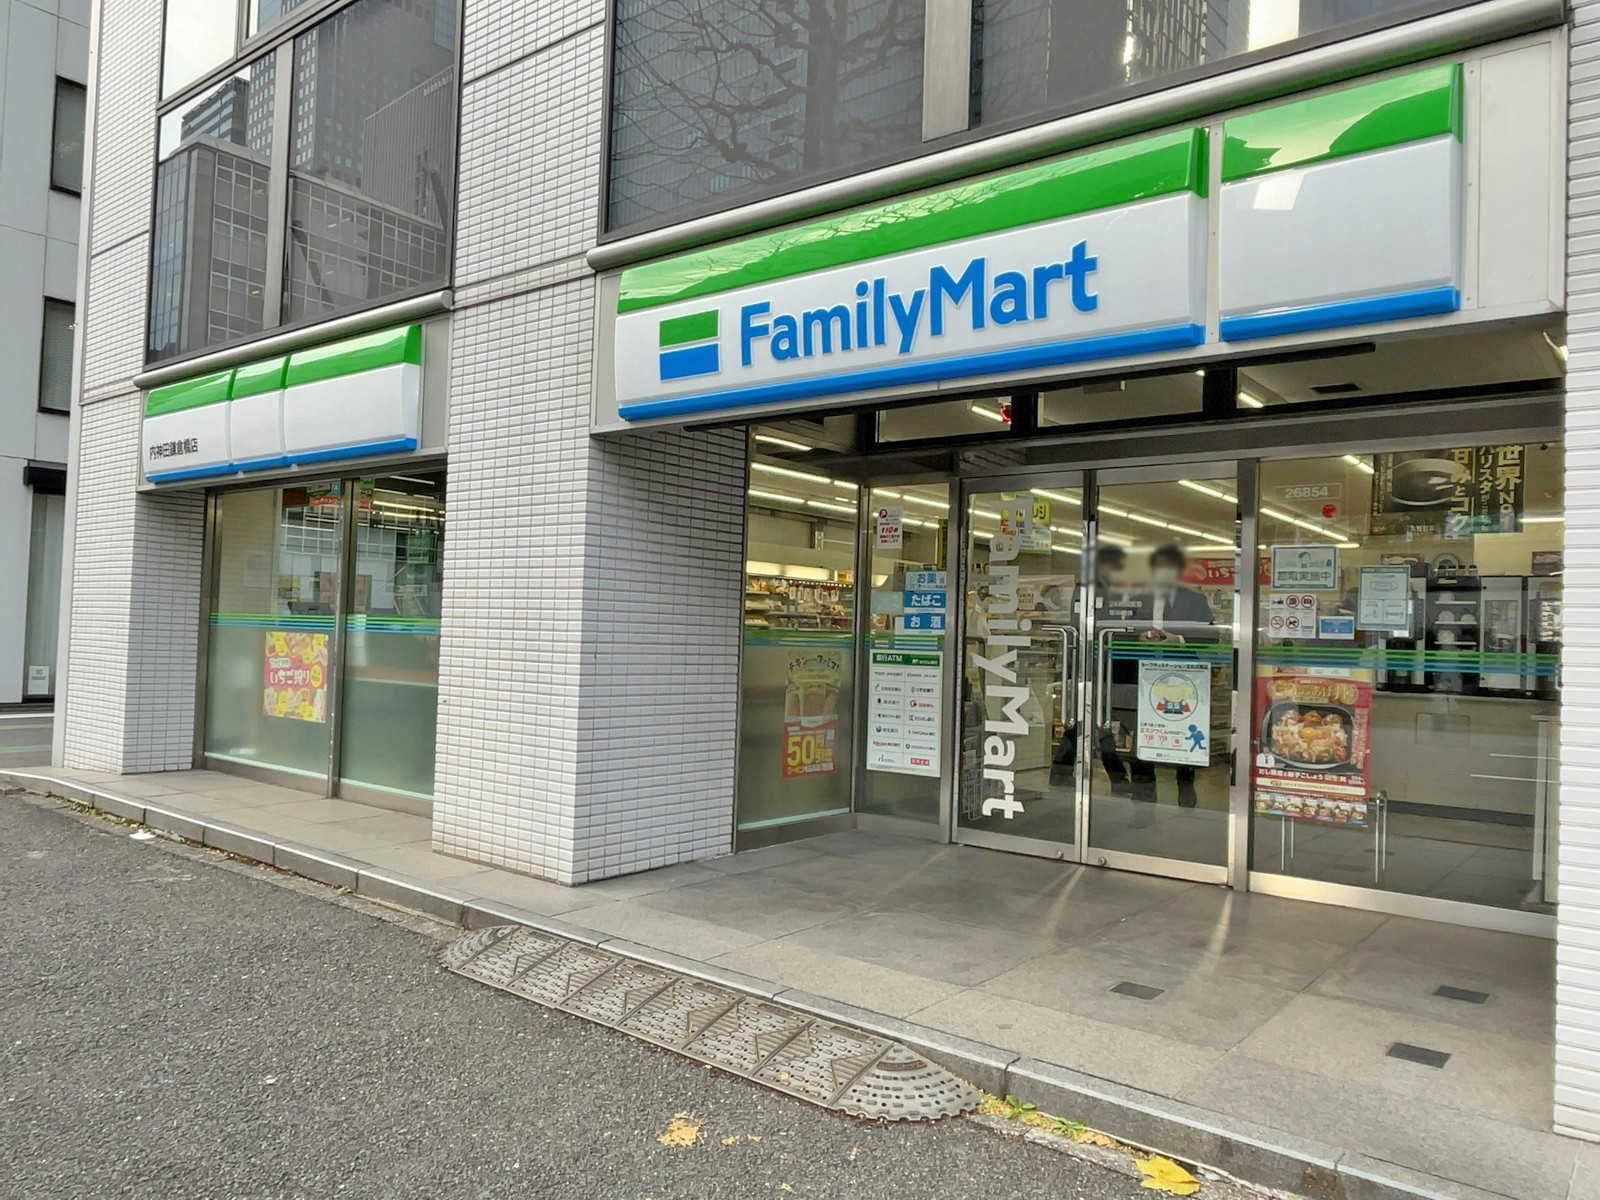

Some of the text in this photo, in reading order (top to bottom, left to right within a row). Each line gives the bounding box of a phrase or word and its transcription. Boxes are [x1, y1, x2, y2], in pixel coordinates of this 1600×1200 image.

[740, 237, 1098, 367] FamilyMart
[149, 437, 198, 460] 内神田鎌倉橋店
[1284, 486, 1329, 499] 26854
[911, 594, 942, 607] たばこ
[972, 498, 1033, 819] FamilyMart
